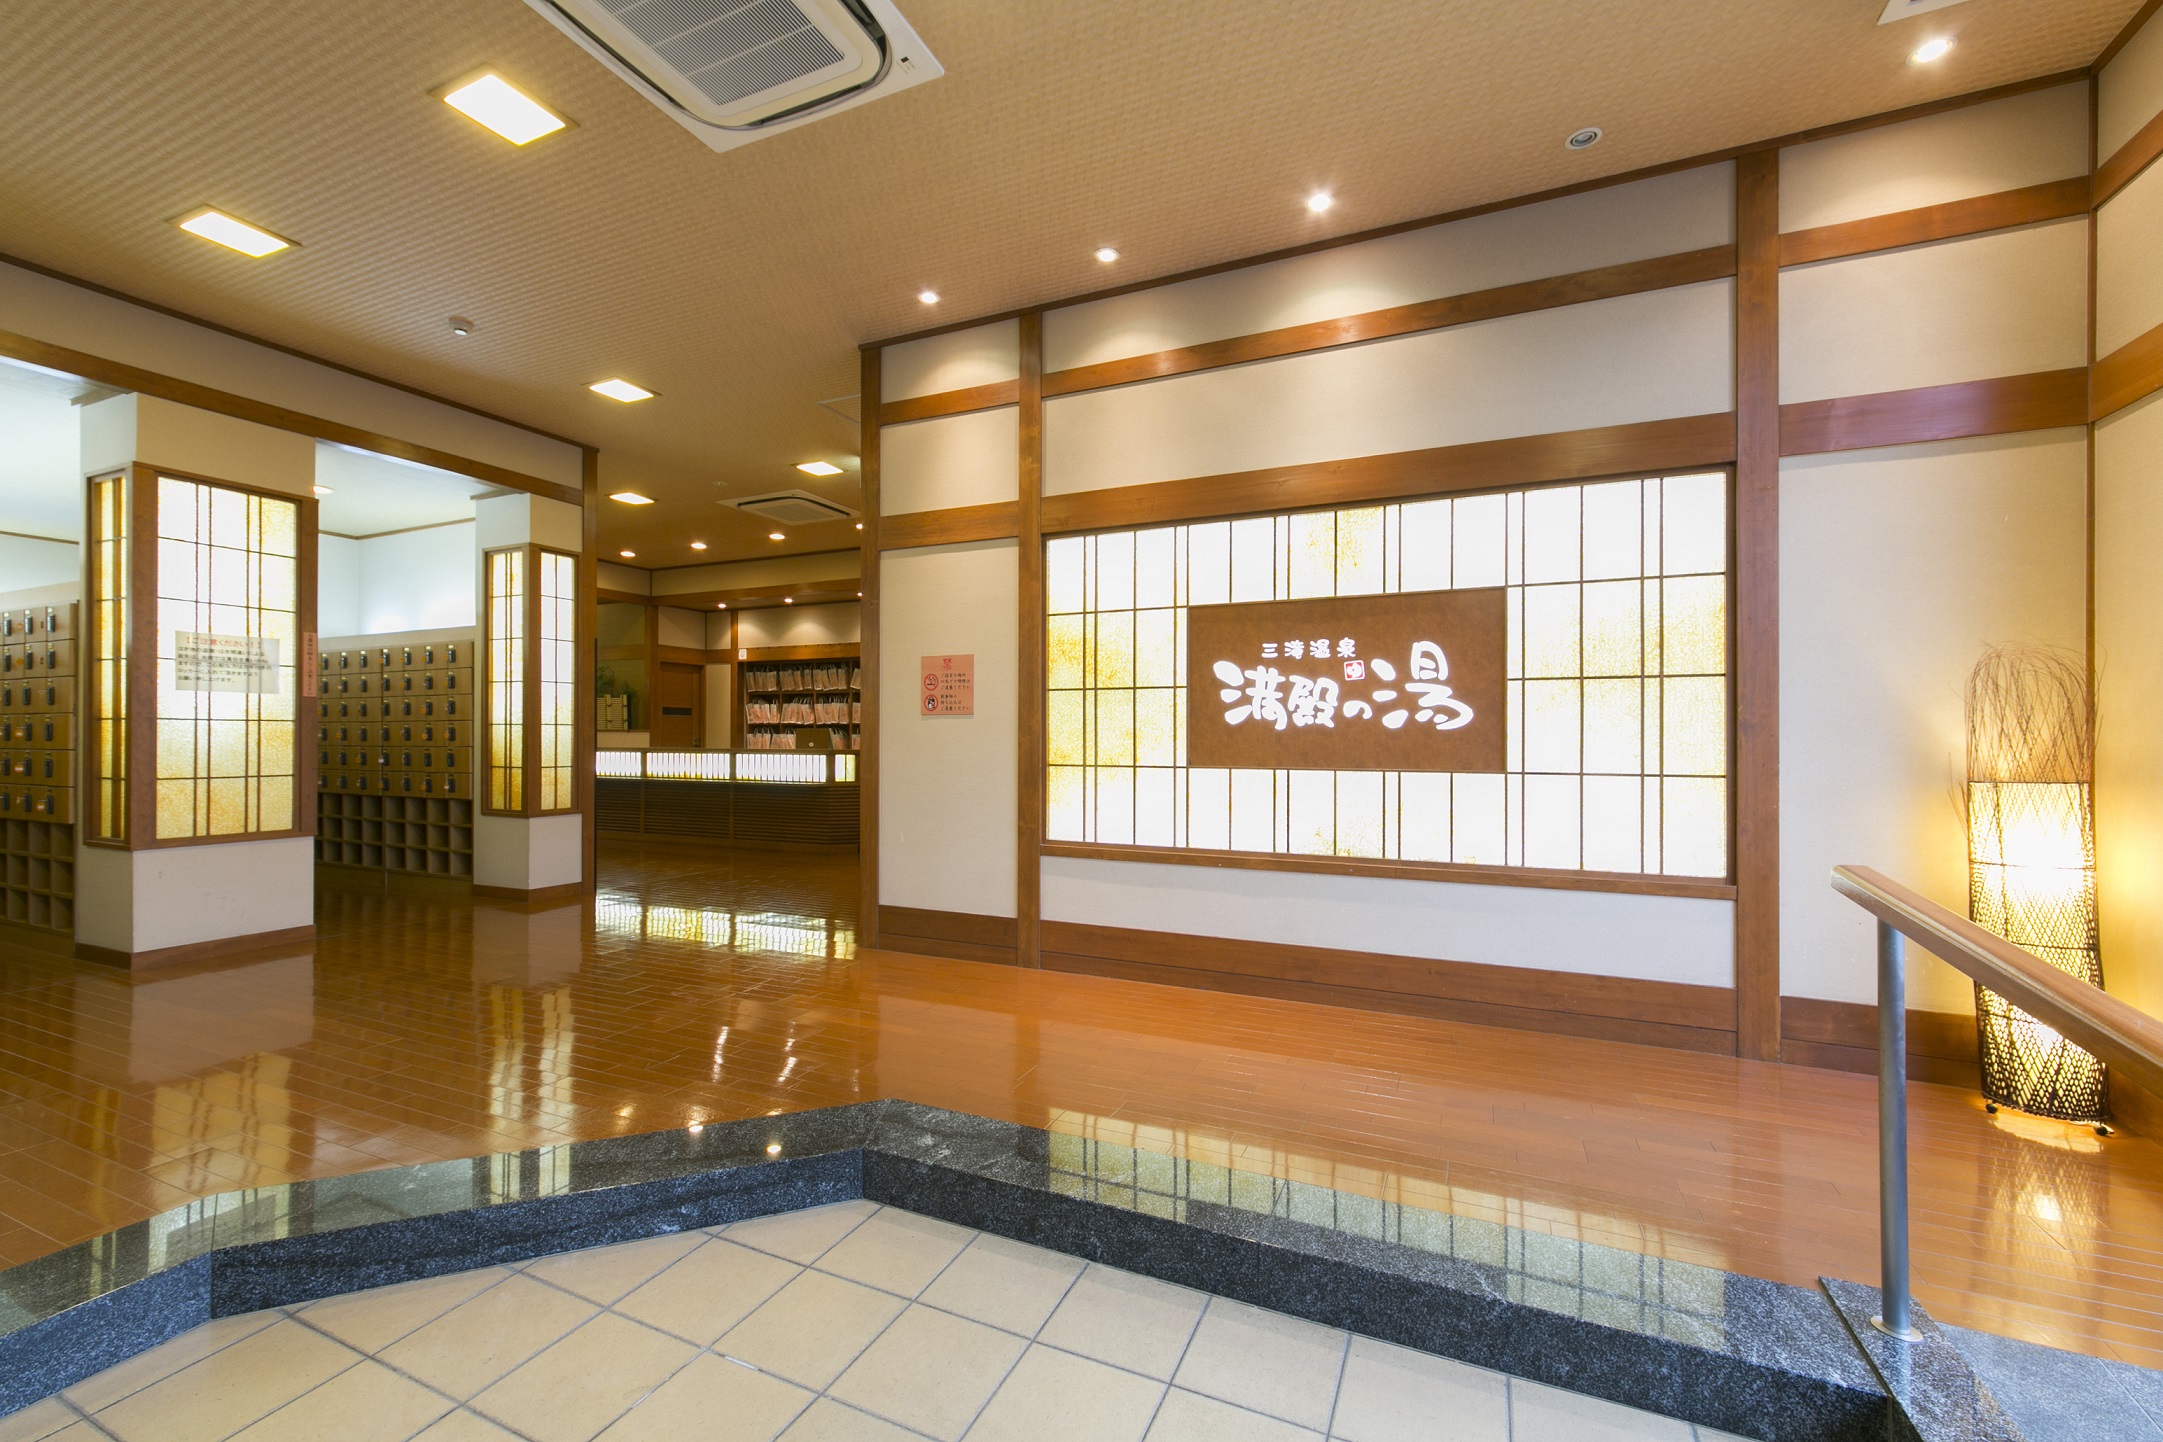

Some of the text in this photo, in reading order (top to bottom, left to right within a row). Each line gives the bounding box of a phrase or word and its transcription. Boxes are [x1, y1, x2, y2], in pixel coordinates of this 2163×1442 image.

[1261, 637, 1356, 660] 三滝温泉
[1213, 641, 1474, 731] 満殿の湯
